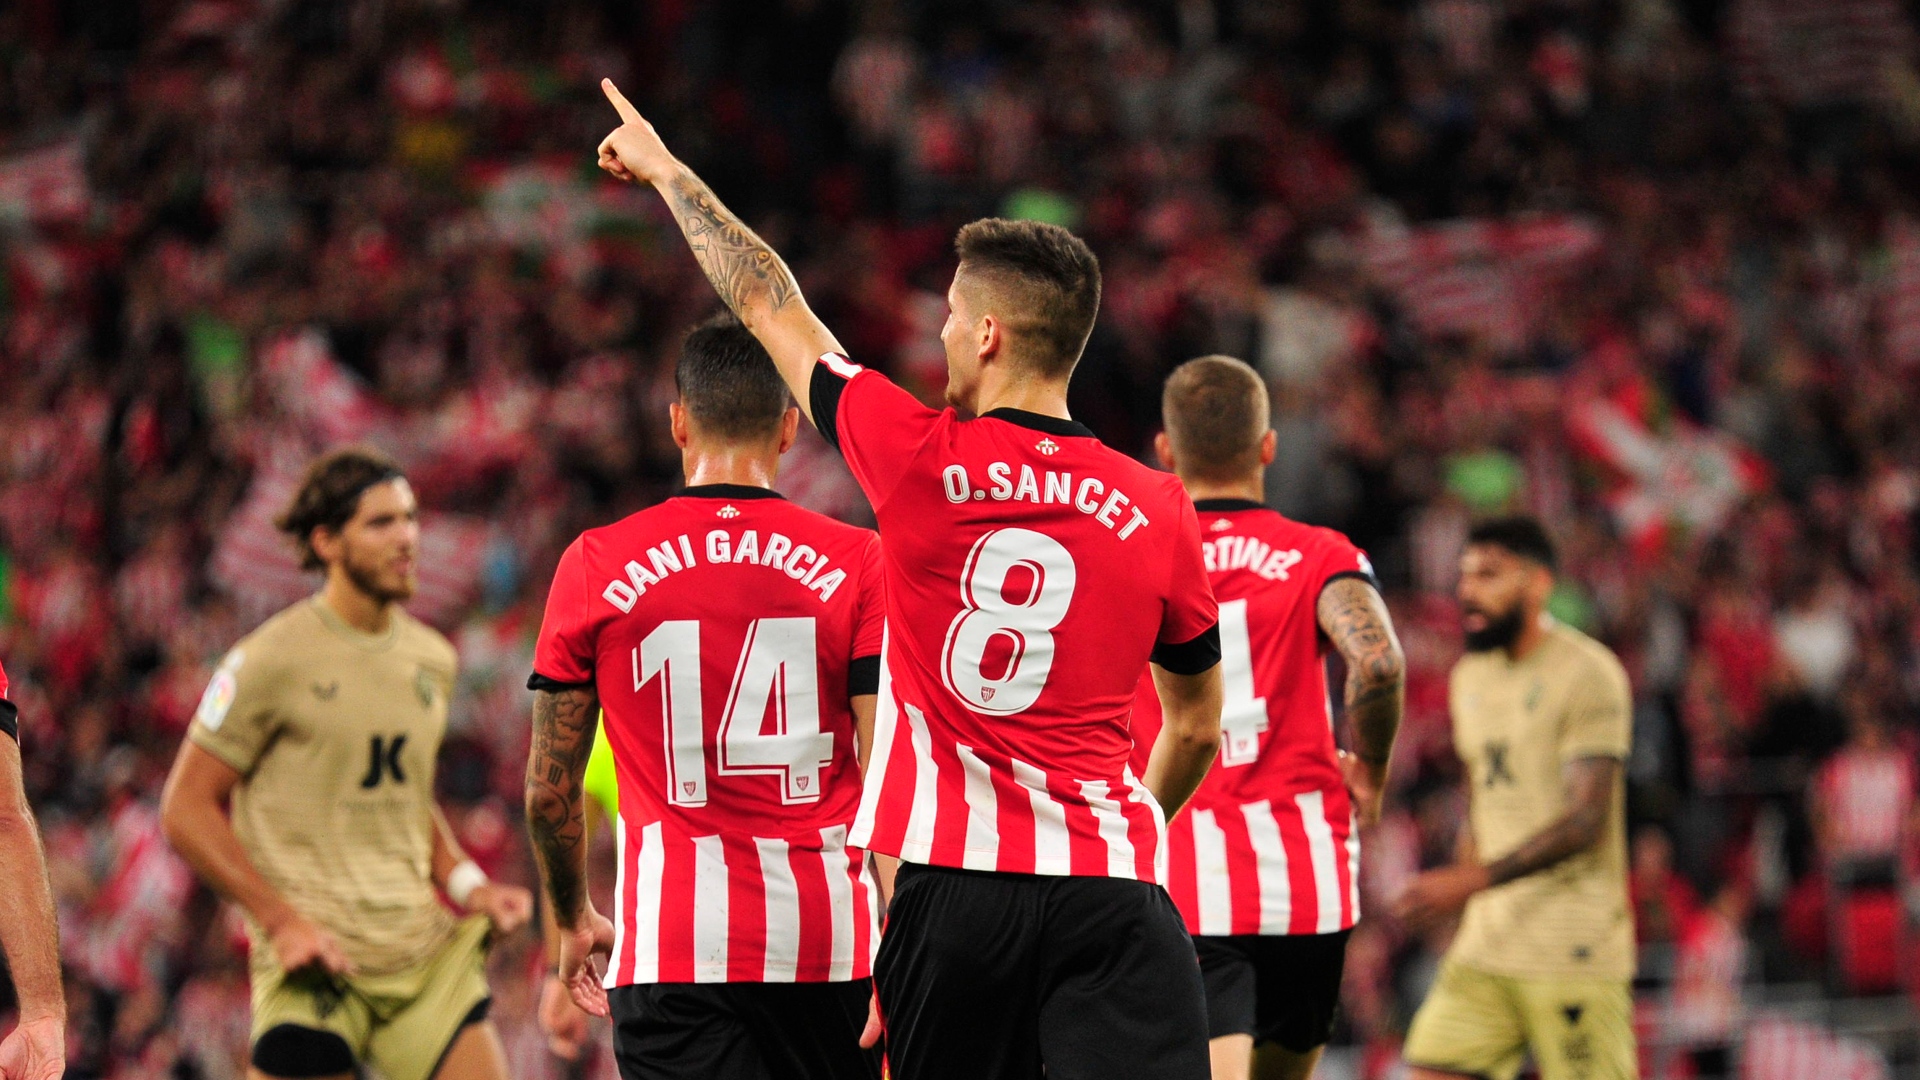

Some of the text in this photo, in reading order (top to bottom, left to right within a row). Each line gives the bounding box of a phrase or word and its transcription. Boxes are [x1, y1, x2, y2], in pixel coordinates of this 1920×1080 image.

[942, 461, 1149, 541] O.SANCET
[602, 529, 847, 614] DANI GARCIA
[1202, 535, 1303, 582] RTINEZ
[940, 527, 1076, 717] 8
[631, 616, 834, 808] 14
[360, 733, 408, 789] JK
